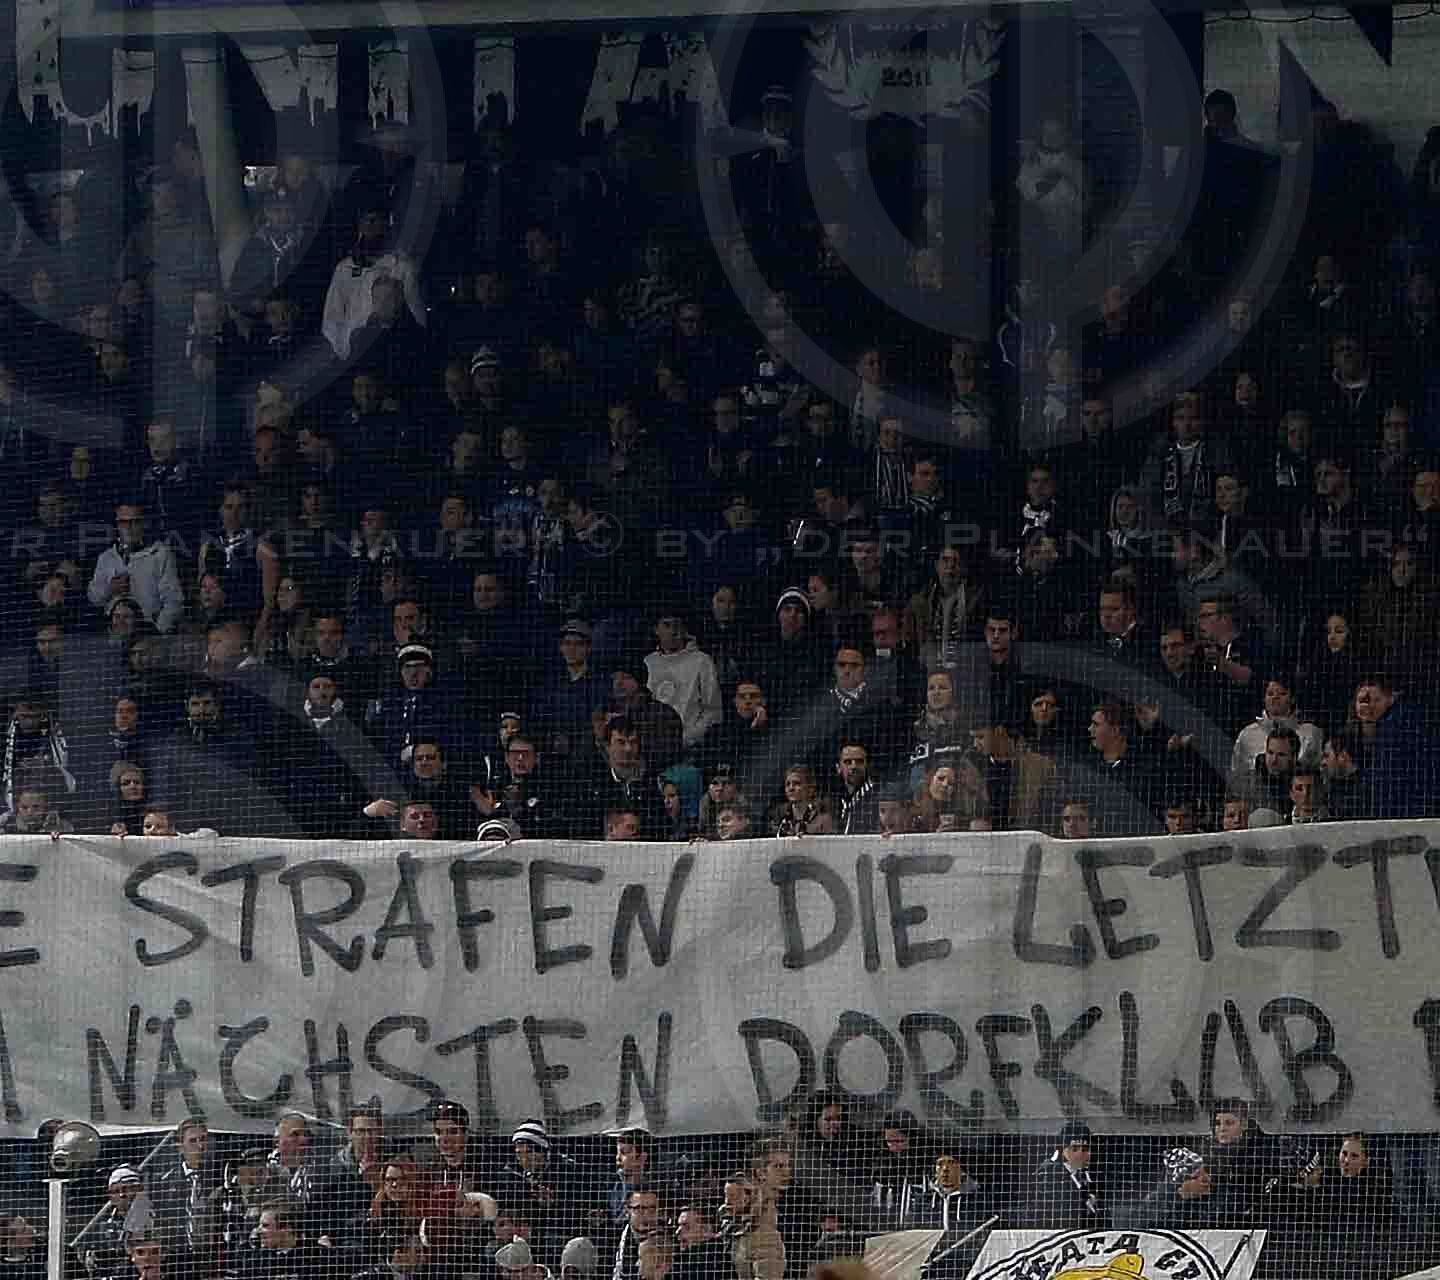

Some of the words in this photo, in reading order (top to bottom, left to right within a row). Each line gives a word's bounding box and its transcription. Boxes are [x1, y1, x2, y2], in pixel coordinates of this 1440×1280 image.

[123, 848, 694, 978] STRAFEN
[769, 852, 955, 973] DIE
[738, 990, 1357, 1122] DORFKLUB
